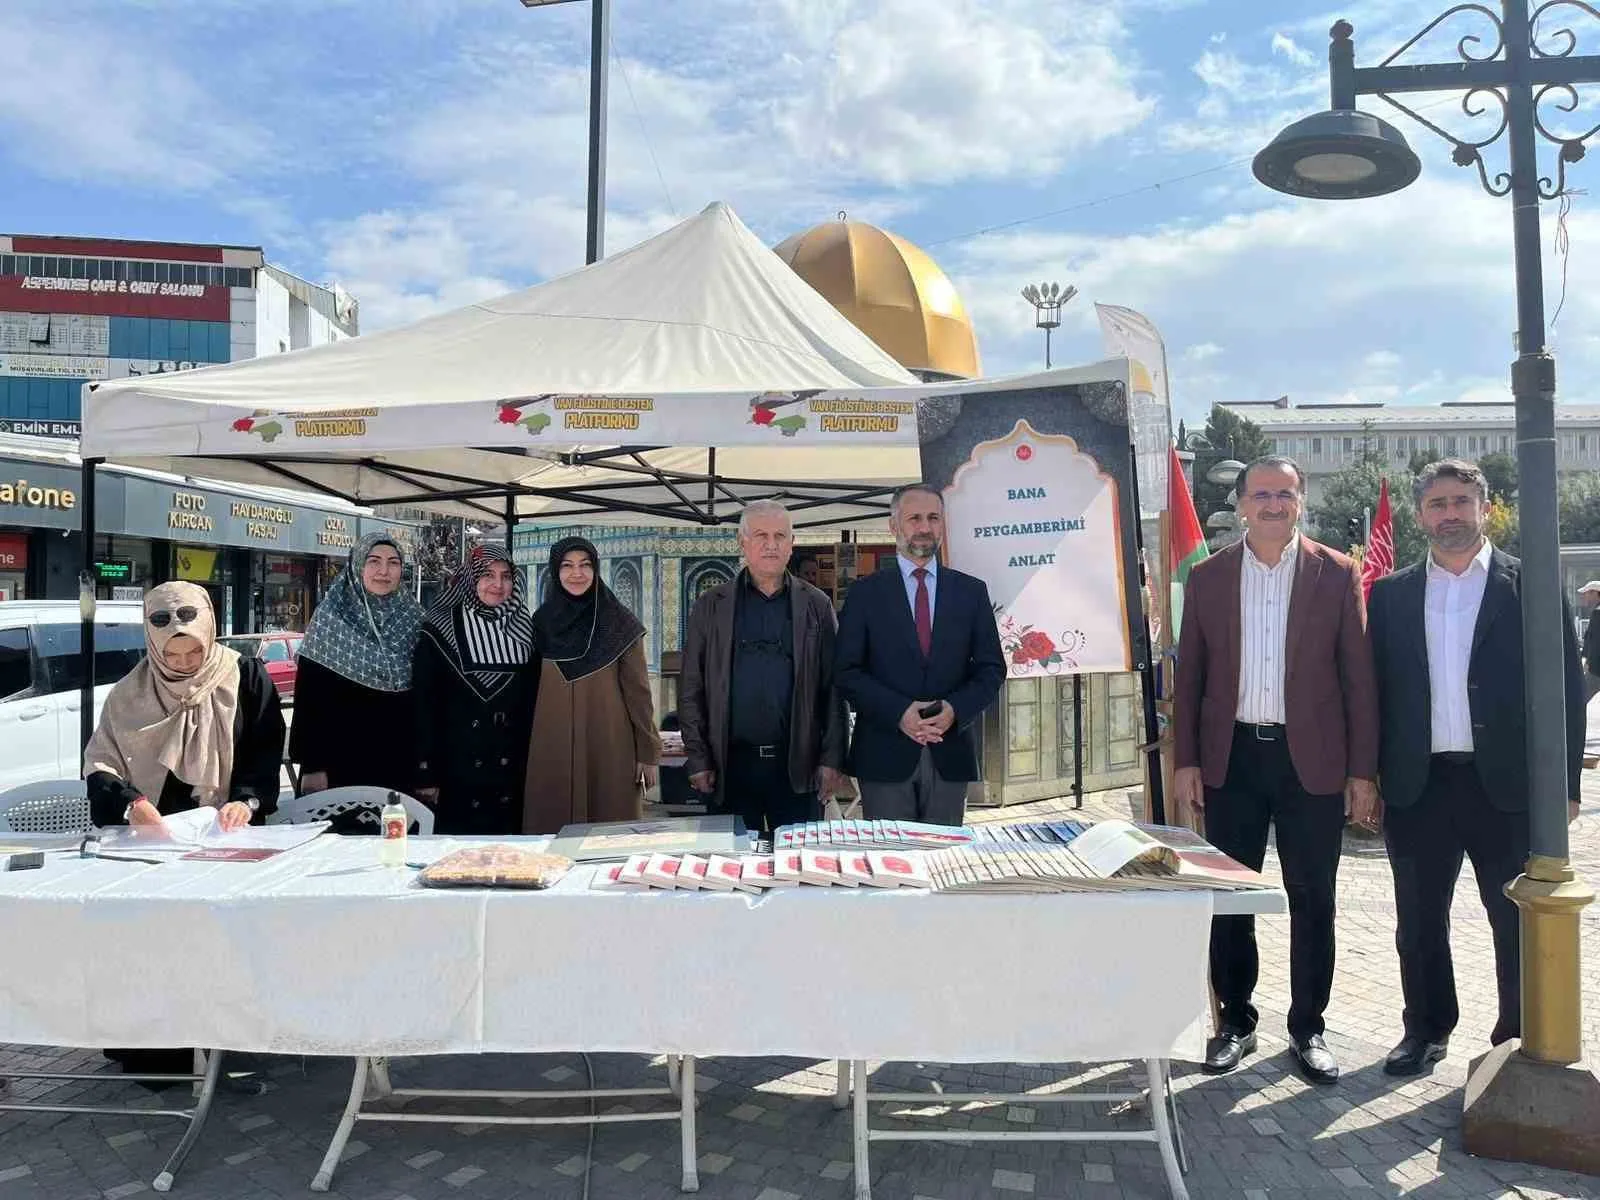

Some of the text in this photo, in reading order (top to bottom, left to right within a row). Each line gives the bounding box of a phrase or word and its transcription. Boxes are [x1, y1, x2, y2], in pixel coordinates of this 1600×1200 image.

[90, 279, 117, 292] CAFE
[118, 280, 128, 292] &
[13, 421, 49, 433] EMİN
[295, 419, 366, 437] PLATFORMU
[565, 412, 639, 430] PLATFORMU
[821, 415, 898, 433] PLATFORMU
[174, 492, 206, 510] FOTO
[1008, 487, 1047, 500] BANA
[168, 511, 213, 531] KIRCAN
[974, 516, 1086, 538] PEYGAMBERİMİ
[1008, 554, 1056, 567] ANLAT
